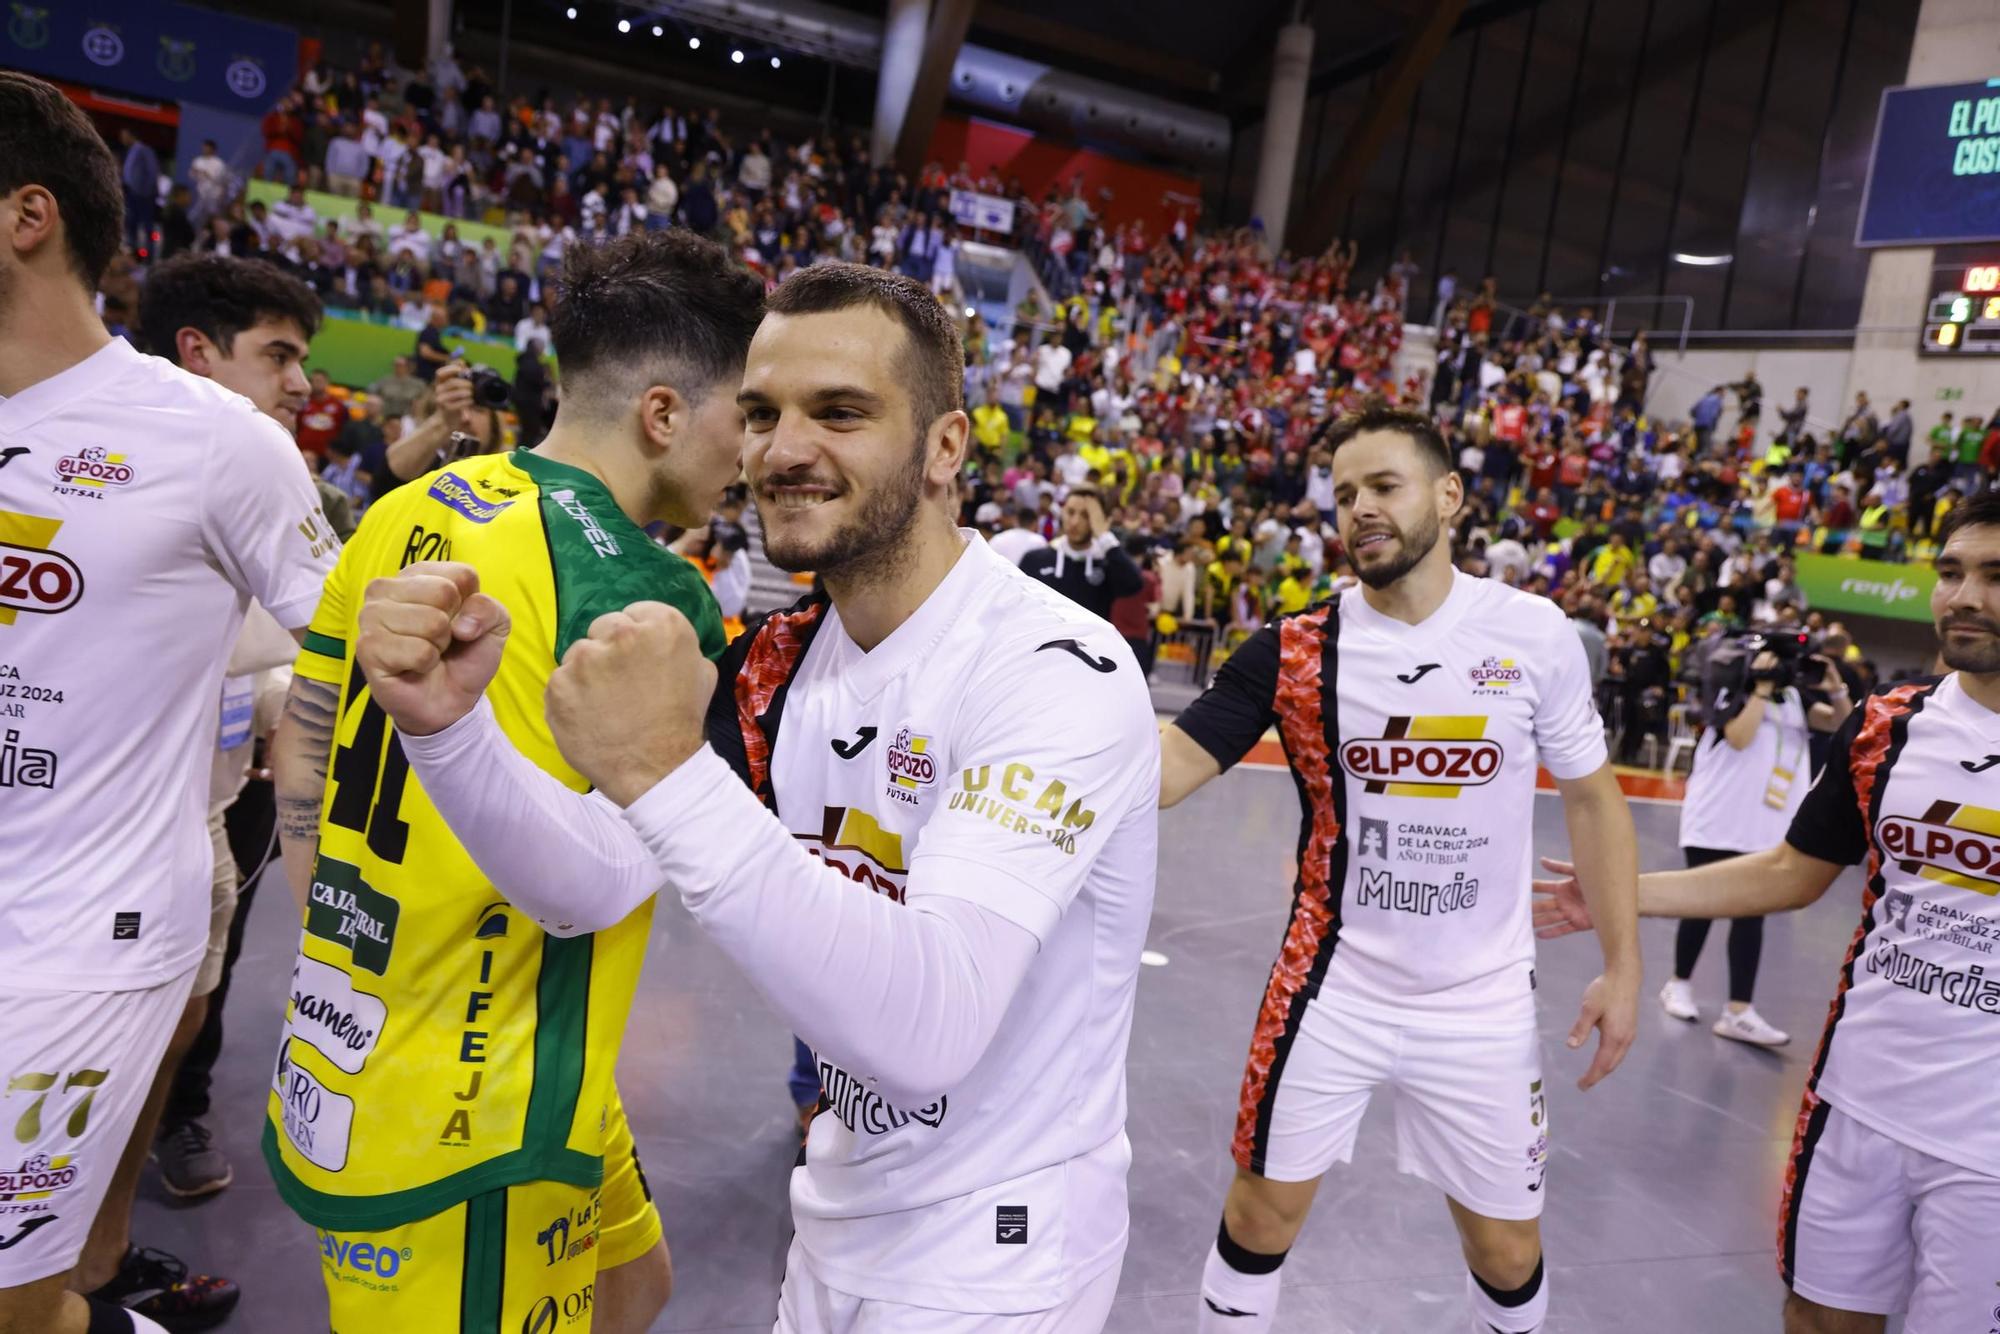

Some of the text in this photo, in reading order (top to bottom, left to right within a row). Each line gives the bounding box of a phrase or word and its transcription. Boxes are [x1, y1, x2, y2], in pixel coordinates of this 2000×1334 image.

[1948, 100, 1971, 137] EL
[53, 486, 104, 500] FUTSAL
[0, 555, 72, 604] ZO
[1841, 577, 1919, 603] renfe
[21, 685, 64, 703] 2024
[886, 787, 919, 805] FUTSAL
[963, 762, 1096, 832] UCAM
[1397, 836, 1413, 848] DE
[1416, 838, 1430, 849] LA
[1433, 839, 1464, 851] CRUZ
[1398, 823, 1468, 837] CARAVACA
[312, 881, 357, 915] CAJA
[1357, 867, 1479, 916] Murcia
[1917, 913, 1934, 927] DE
[440, 950, 493, 1141] IFEJA
[7, 1069, 110, 1145] 77
